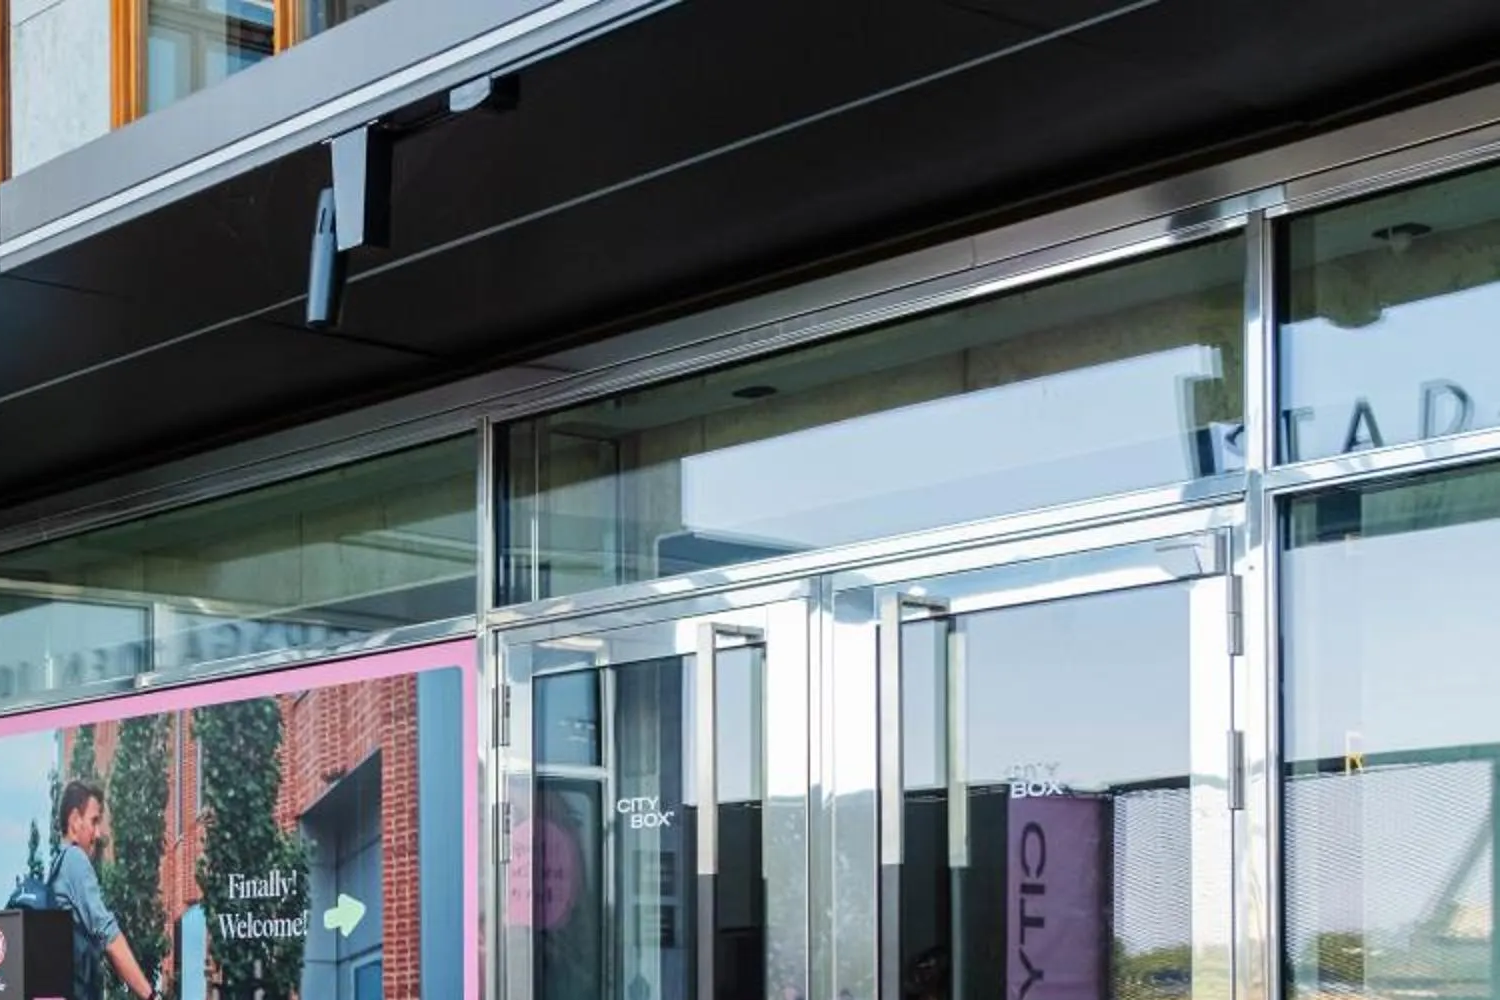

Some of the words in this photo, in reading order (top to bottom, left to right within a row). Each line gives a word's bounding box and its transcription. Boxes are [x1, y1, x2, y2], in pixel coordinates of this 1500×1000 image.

[617, 796, 659, 813] CITY
[228, 870, 298, 902] Finally!
[218, 910, 309, 941] Welcome!
